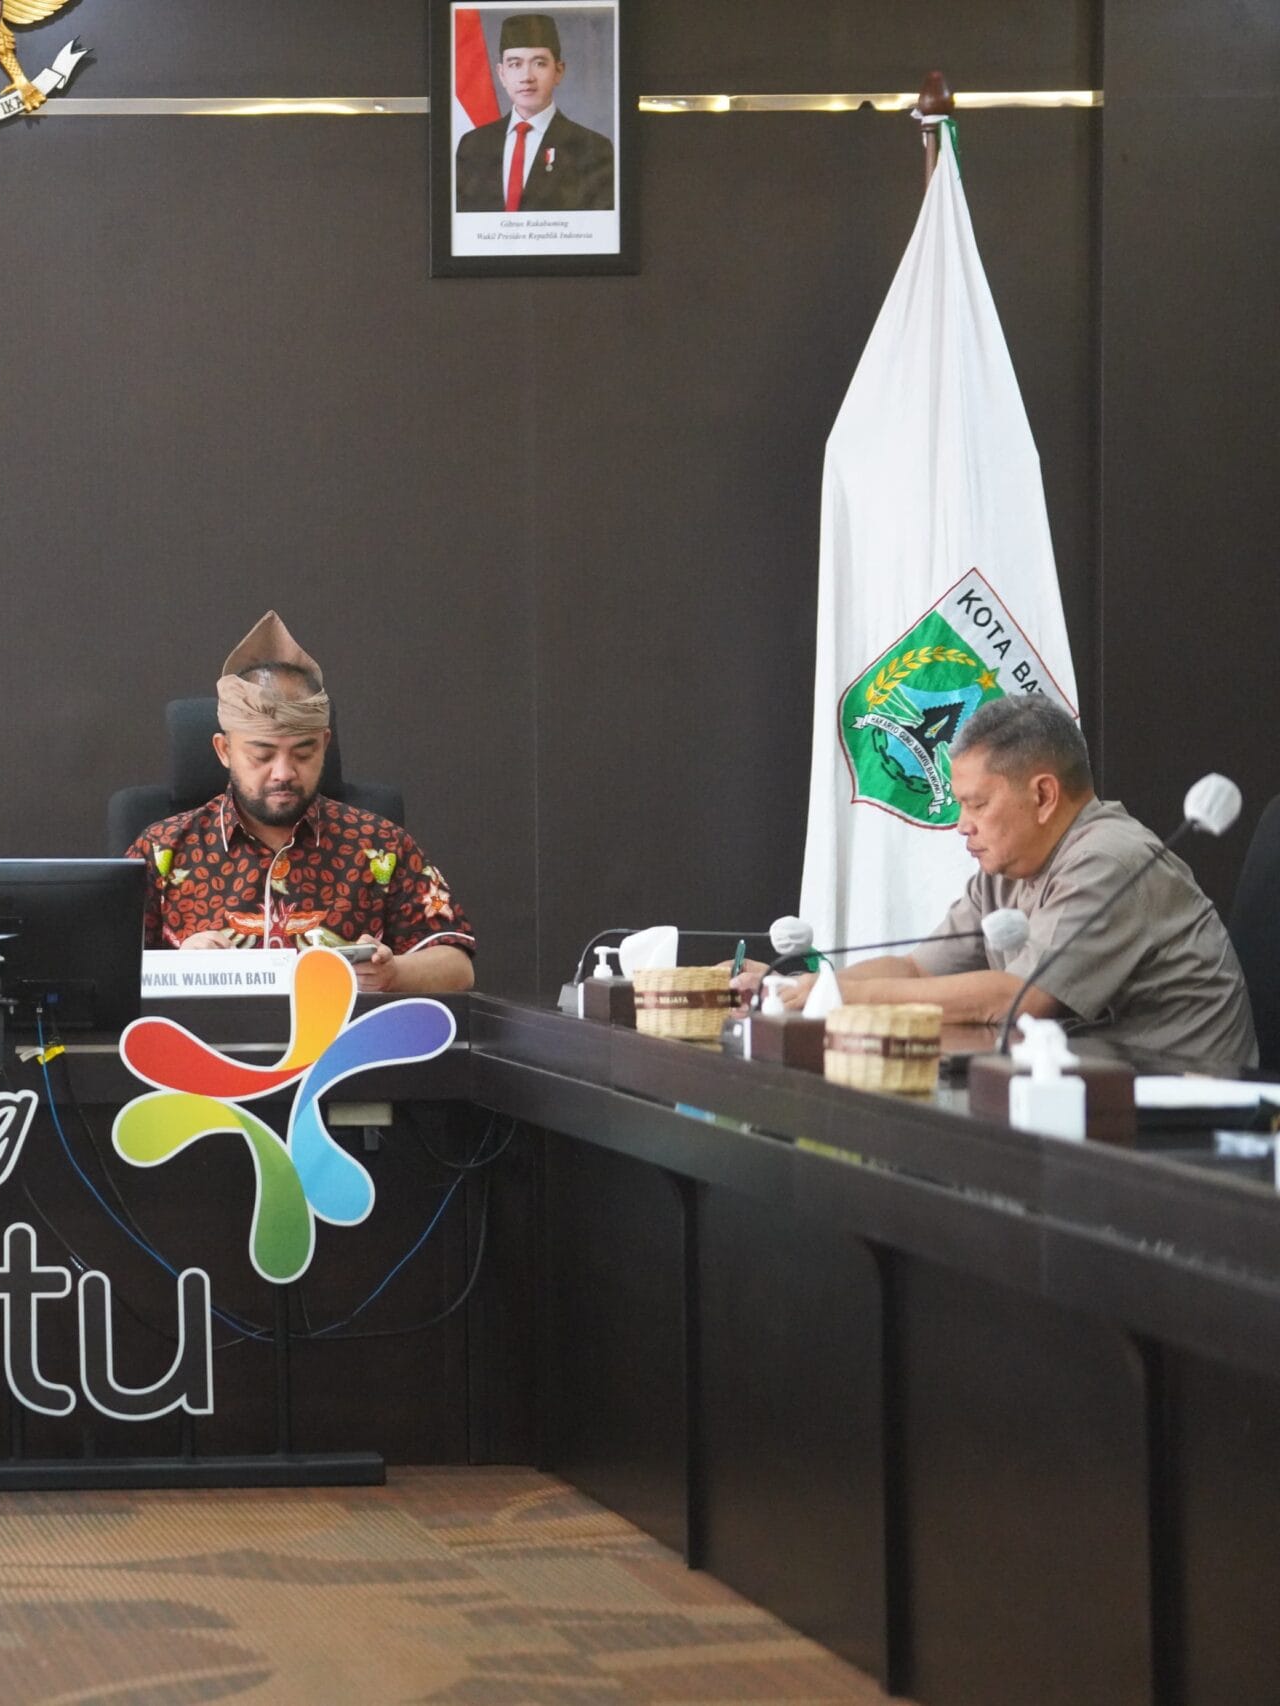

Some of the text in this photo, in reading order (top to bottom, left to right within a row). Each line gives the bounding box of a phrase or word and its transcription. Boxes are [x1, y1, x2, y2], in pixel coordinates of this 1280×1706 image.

[0, 96, 25, 115] IKA
[476, 232, 497, 240] Wakil
[497, 232, 527, 240] Presiden
[527, 232, 558, 241] Republik
[957, 588, 1013, 660] KOTA
[141, 972, 276, 987] WAKIL WALIKOTA BATU
